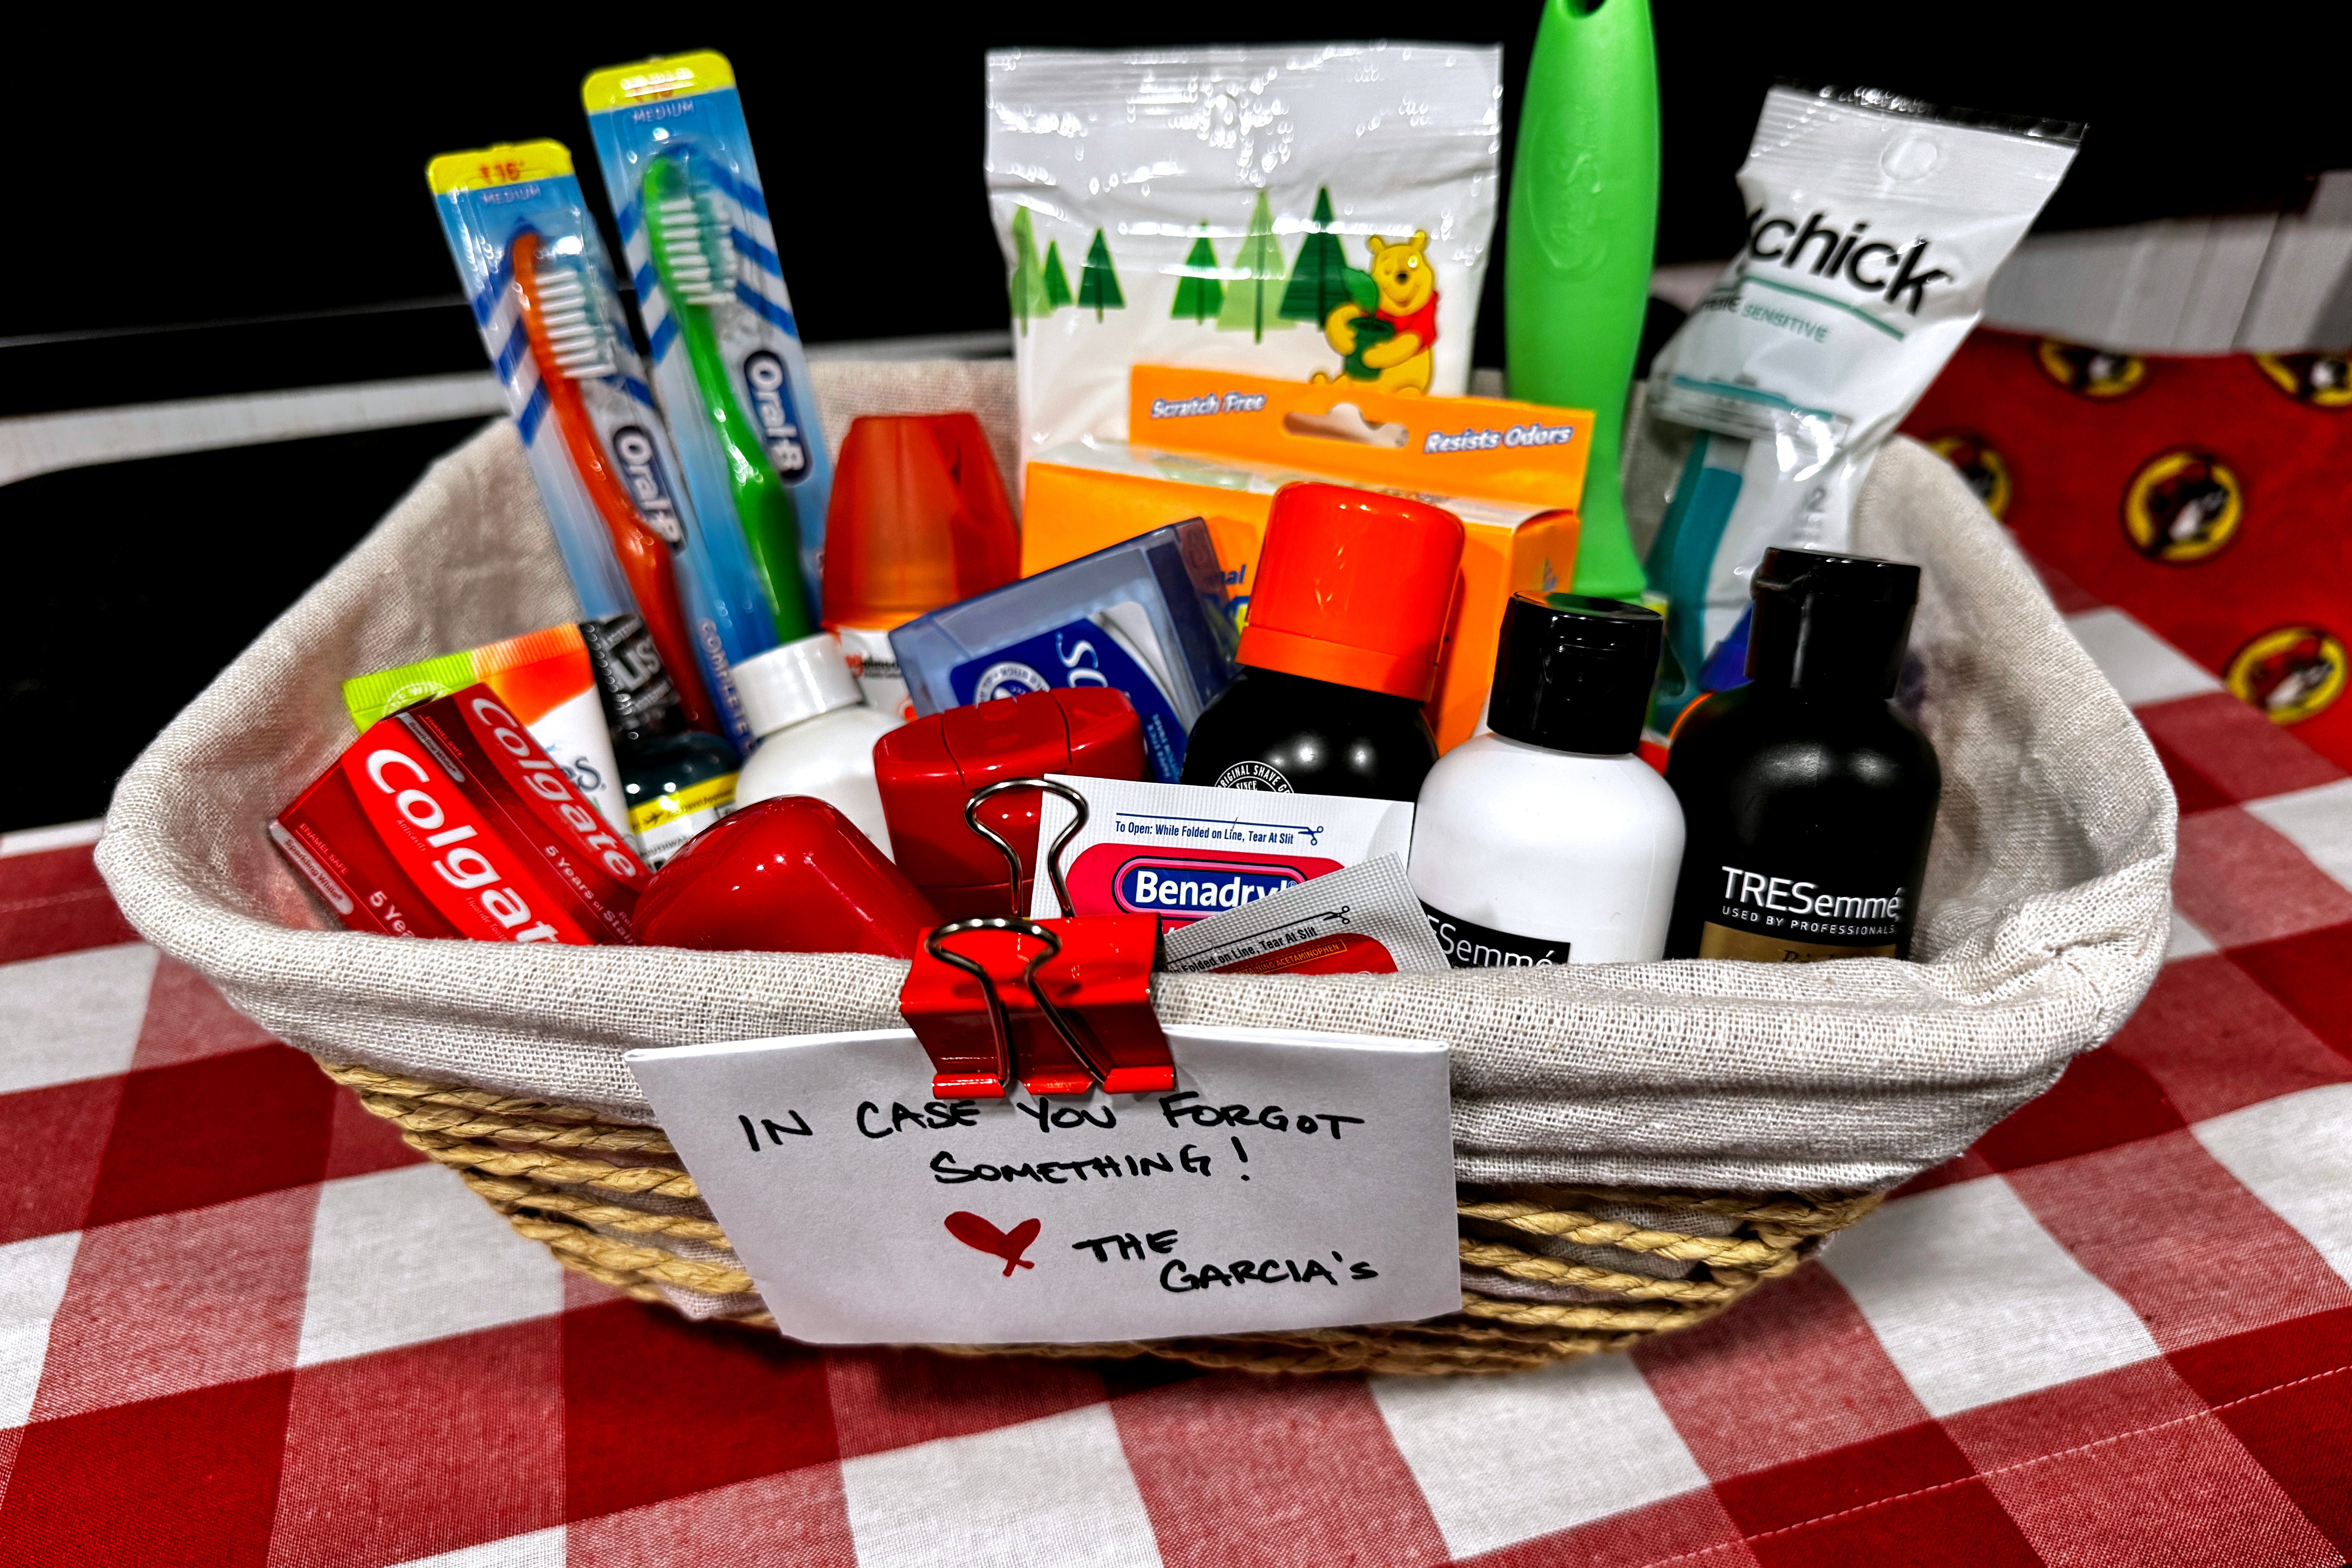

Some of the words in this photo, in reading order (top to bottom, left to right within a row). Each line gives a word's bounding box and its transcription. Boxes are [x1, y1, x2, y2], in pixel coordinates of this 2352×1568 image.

[633, 99, 694, 123] MEDIUM
[1736, 208, 1954, 316] chick
[1741, 304, 1829, 343] SENSITIVE
[751, 359, 804, 471] Oral-B
[1151, 392, 1219, 418] Scratch
[1223, 392, 1267, 413] Free
[1424, 429, 1502, 453] Resists
[1504, 423, 1573, 448] Odors
[472, 698, 636, 877] Colgate
[1253, 765, 1281, 786] SHAVE
[299, 823, 329, 854] ENAMEL
[330, 854, 349, 875] SAFE
[366, 749, 559, 943] Colgat
[1115, 821, 1125, 832] To
[1128, 824, 1153, 835] Open:
[1156, 824, 1179, 836] While
[1181, 826, 1209, 838] Folded
[1211, 830, 1221, 839] on
[1224, 828, 1245, 842] Line,
[1248, 831, 1267, 842] Tear
[1269, 833, 1277, 844] At
[1279, 833, 1294, 845] Slit
[285, 839, 319, 877] Sparkling
[546, 846, 559, 857] 5
[558, 857, 594, 899] Years
[369, 890, 388, 907] 5
[1722, 866, 1902, 919] TRESemmé
[1722, 905, 1759, 922] USED
[1766, 916, 1785, 926] BY
[1790, 920, 1895, 936] PROFESSIONALS
[1181, 957, 1217, 972] Folded
[1218, 953, 1232, 963] on
[1231, 947, 1260, 959] Line,
[1258, 936, 1284, 950] Tear
[1286, 933, 1297, 946] At
[1298, 926, 1318, 943] Slit
[1276, 943, 1339, 967] ACETAMINOPHEN
[739, 1109, 813, 1152] IN
[857, 1100, 981, 1139] CASE
[1017, 1097, 1117, 1133] YOU
[1159, 1091, 1365, 1139] FORGOT
[1072, 1229, 1178, 1262] THE
